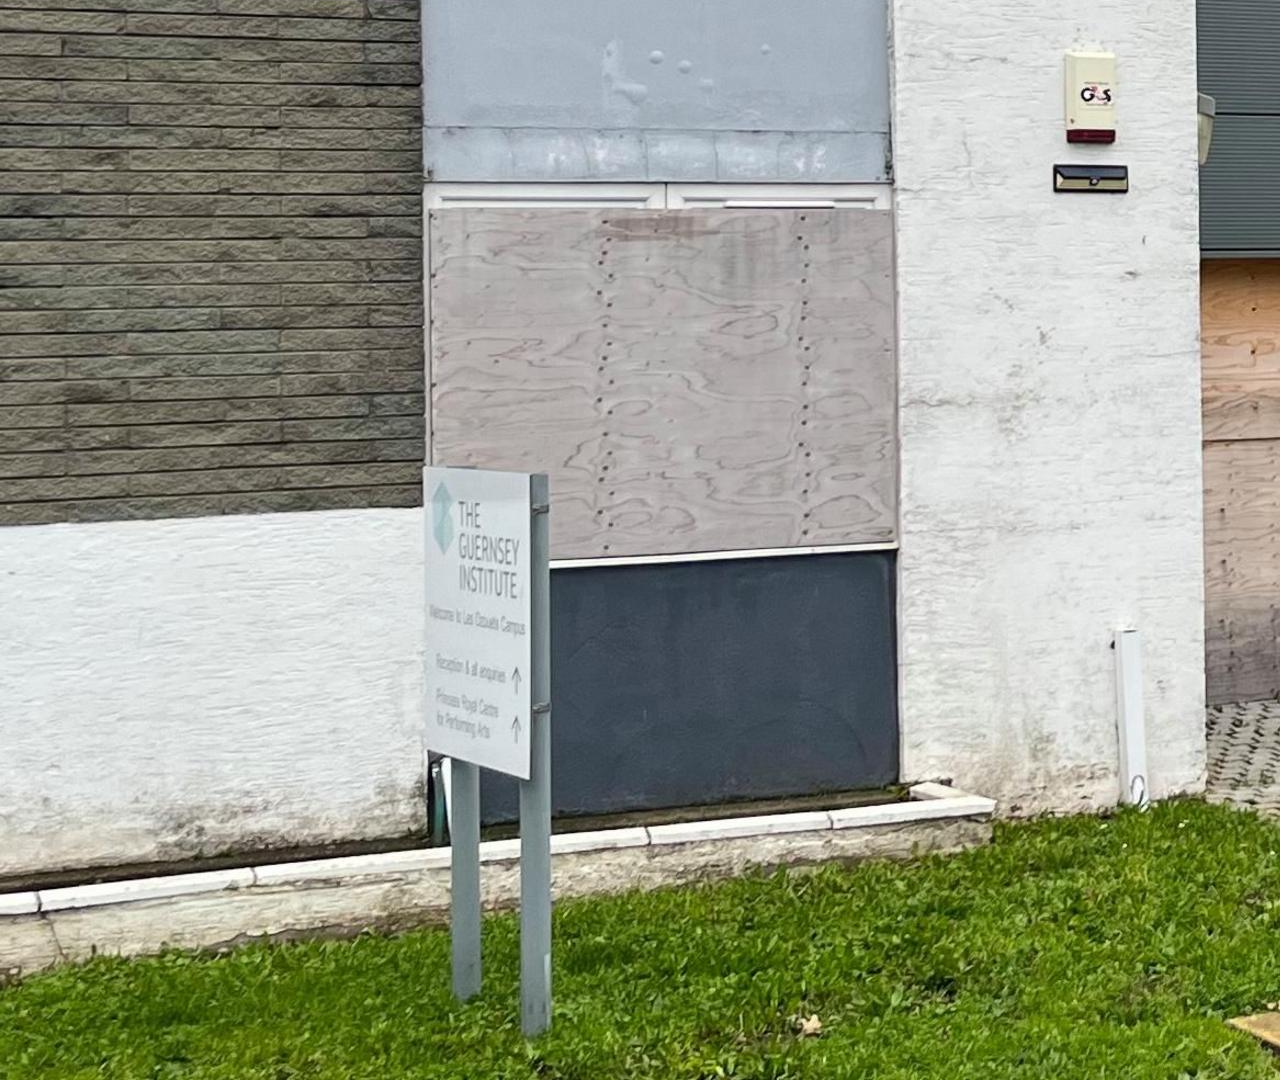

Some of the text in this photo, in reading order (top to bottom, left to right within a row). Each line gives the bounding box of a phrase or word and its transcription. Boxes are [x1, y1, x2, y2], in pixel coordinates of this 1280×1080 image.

[459, 501, 480, 529] THE
[459, 533, 519, 566] GUERNSEY
[459, 565, 518, 599] INSTITUTE
